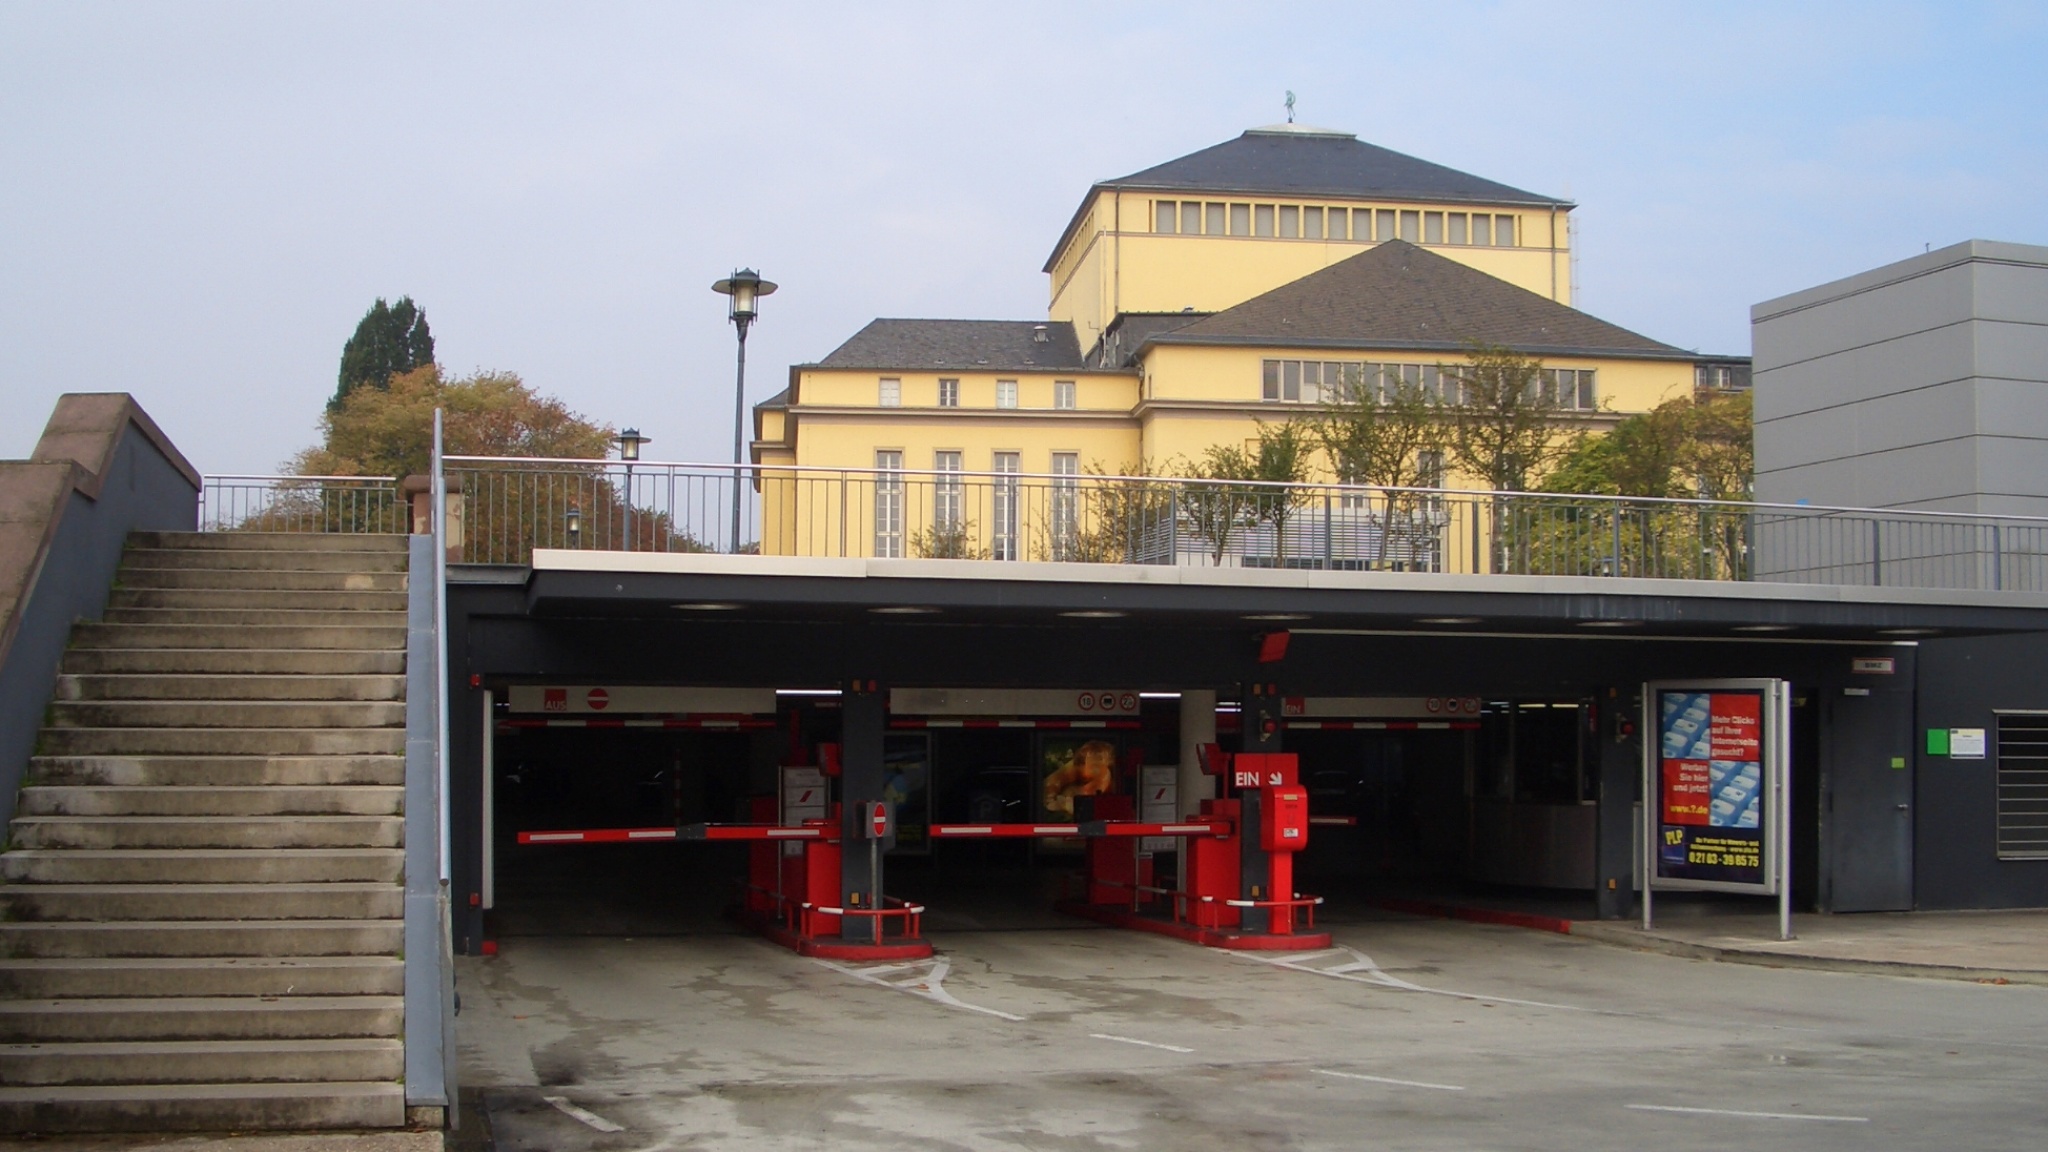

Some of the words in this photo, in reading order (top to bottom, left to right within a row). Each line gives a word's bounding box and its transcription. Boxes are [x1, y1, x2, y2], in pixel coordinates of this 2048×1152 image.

[545, 700, 566, 711] AUS
[1286, 704, 1302, 715] EIN
[1712, 716, 1730, 724] Mehr
[1712, 737, 1759, 746] Internetseite
[1711, 748, 1744, 757] gesucht?
[1680, 763, 1708, 772] Werben
[1235, 771, 1260, 787] EIN
[1679, 773, 1692, 782] Sie
[1694, 774, 1708, 782] hier
[1673, 784, 1688, 792] und
[1689, 784, 1708, 793] jetzt!
[1670, 805, 1708, 814] www.?.de
[1665, 829, 1683, 845] PLP
